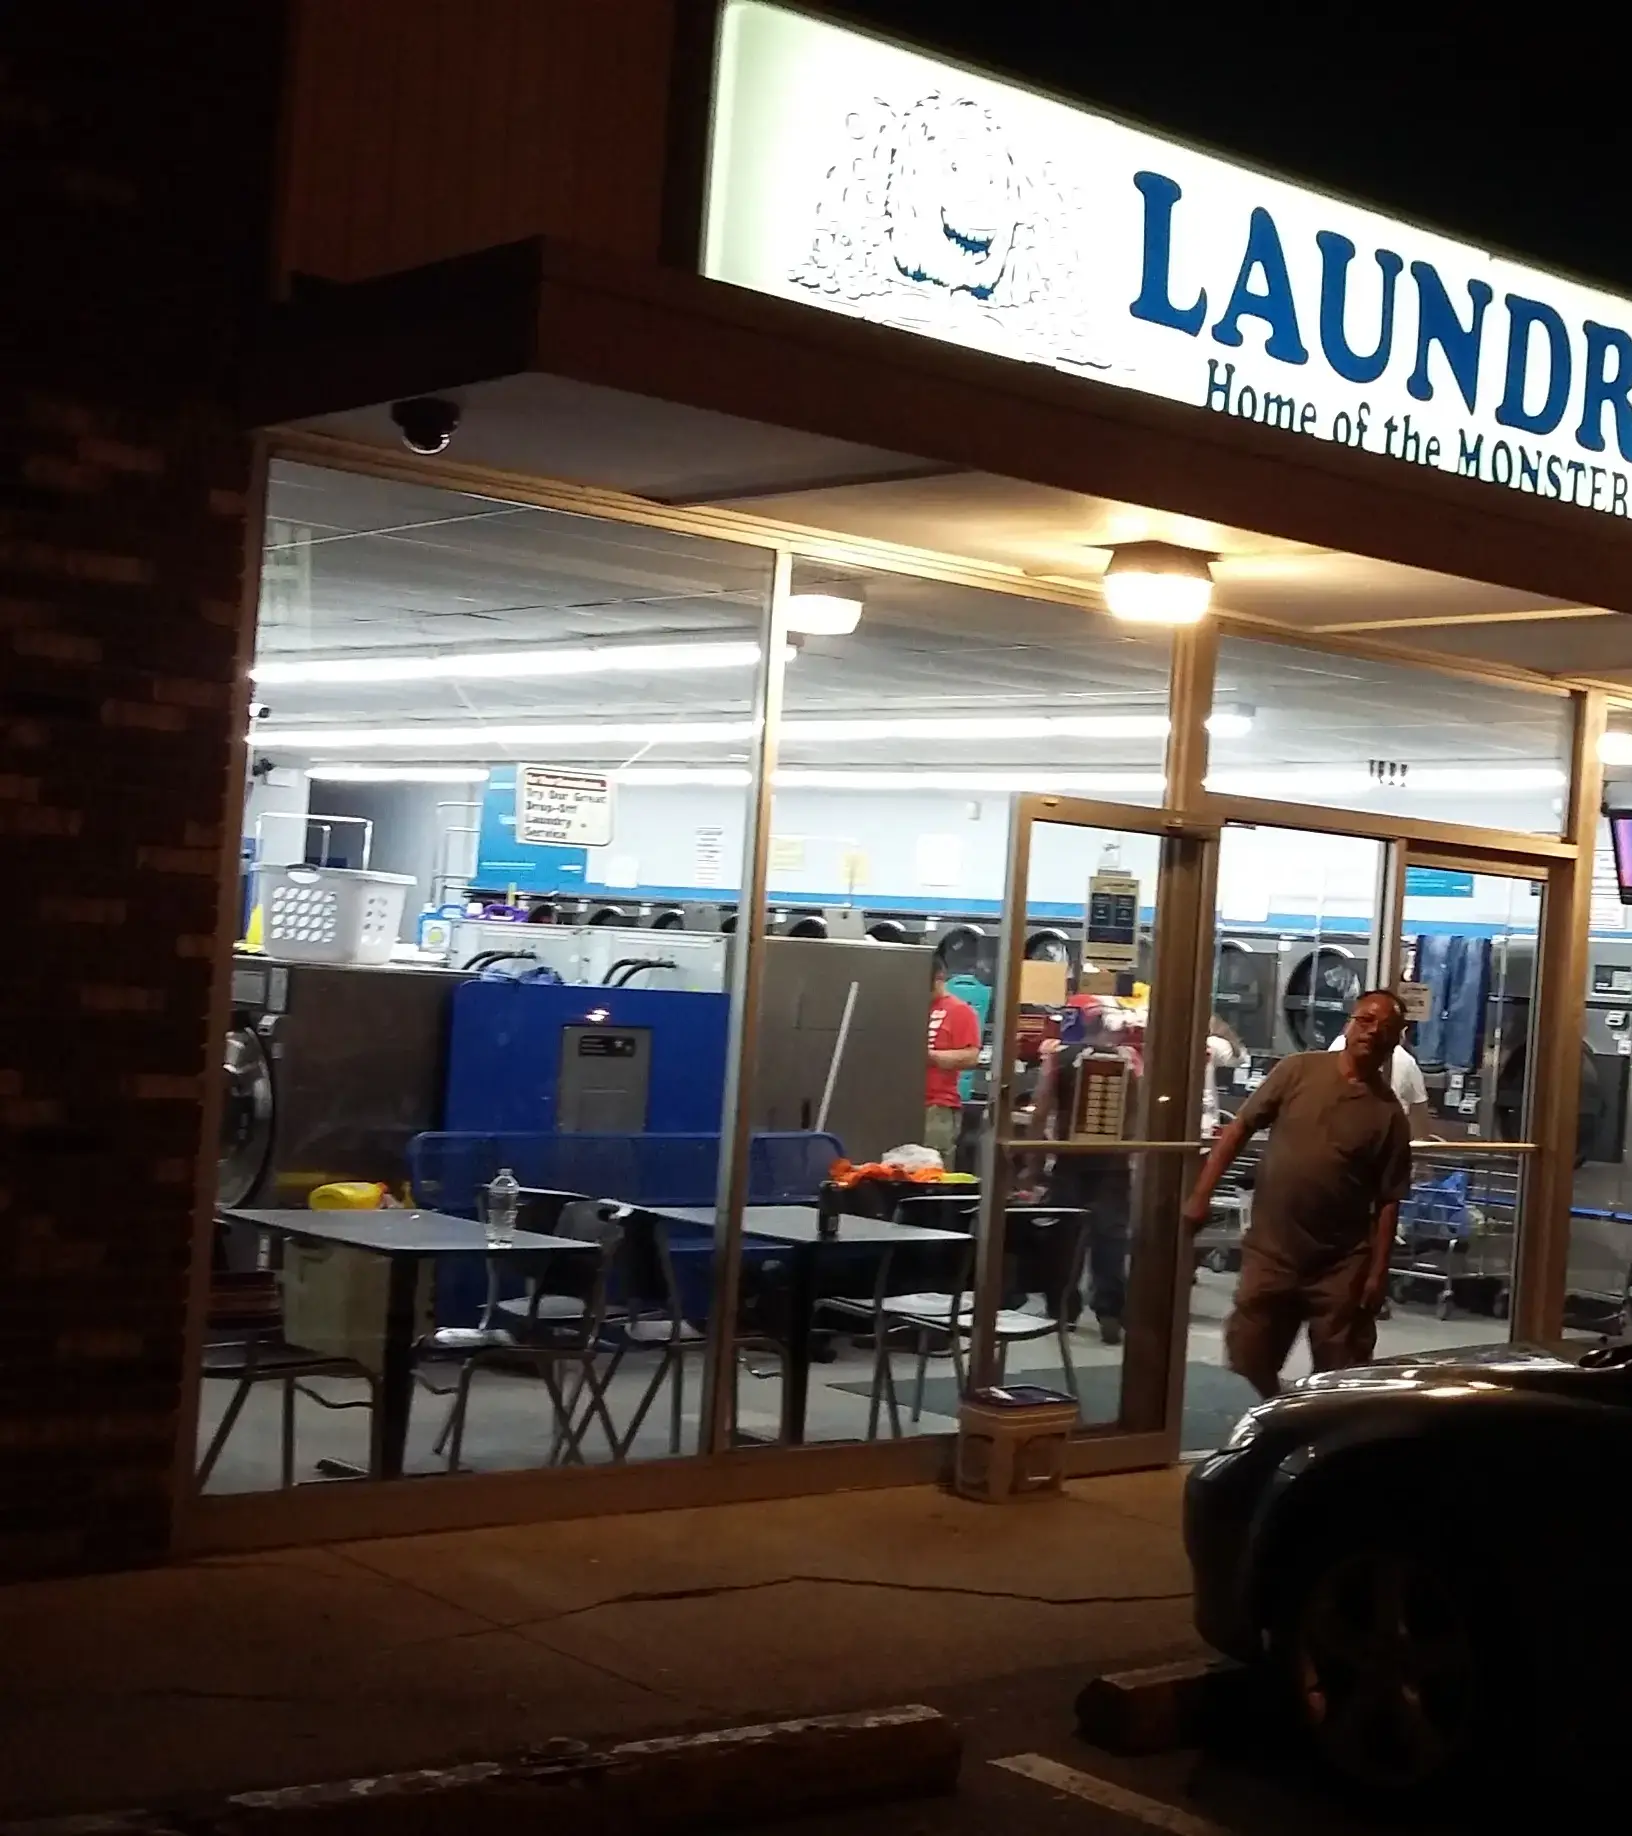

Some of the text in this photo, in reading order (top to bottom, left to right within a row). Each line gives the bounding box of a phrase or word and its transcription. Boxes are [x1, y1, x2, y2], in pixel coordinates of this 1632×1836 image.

[1205, 357, 1318, 438] Home
[1332, 401, 1371, 448] of
[1384, 414, 1441, 468] the
[1457, 427, 1629, 517] MONSTER
[525, 813, 572, 829] Laundry
